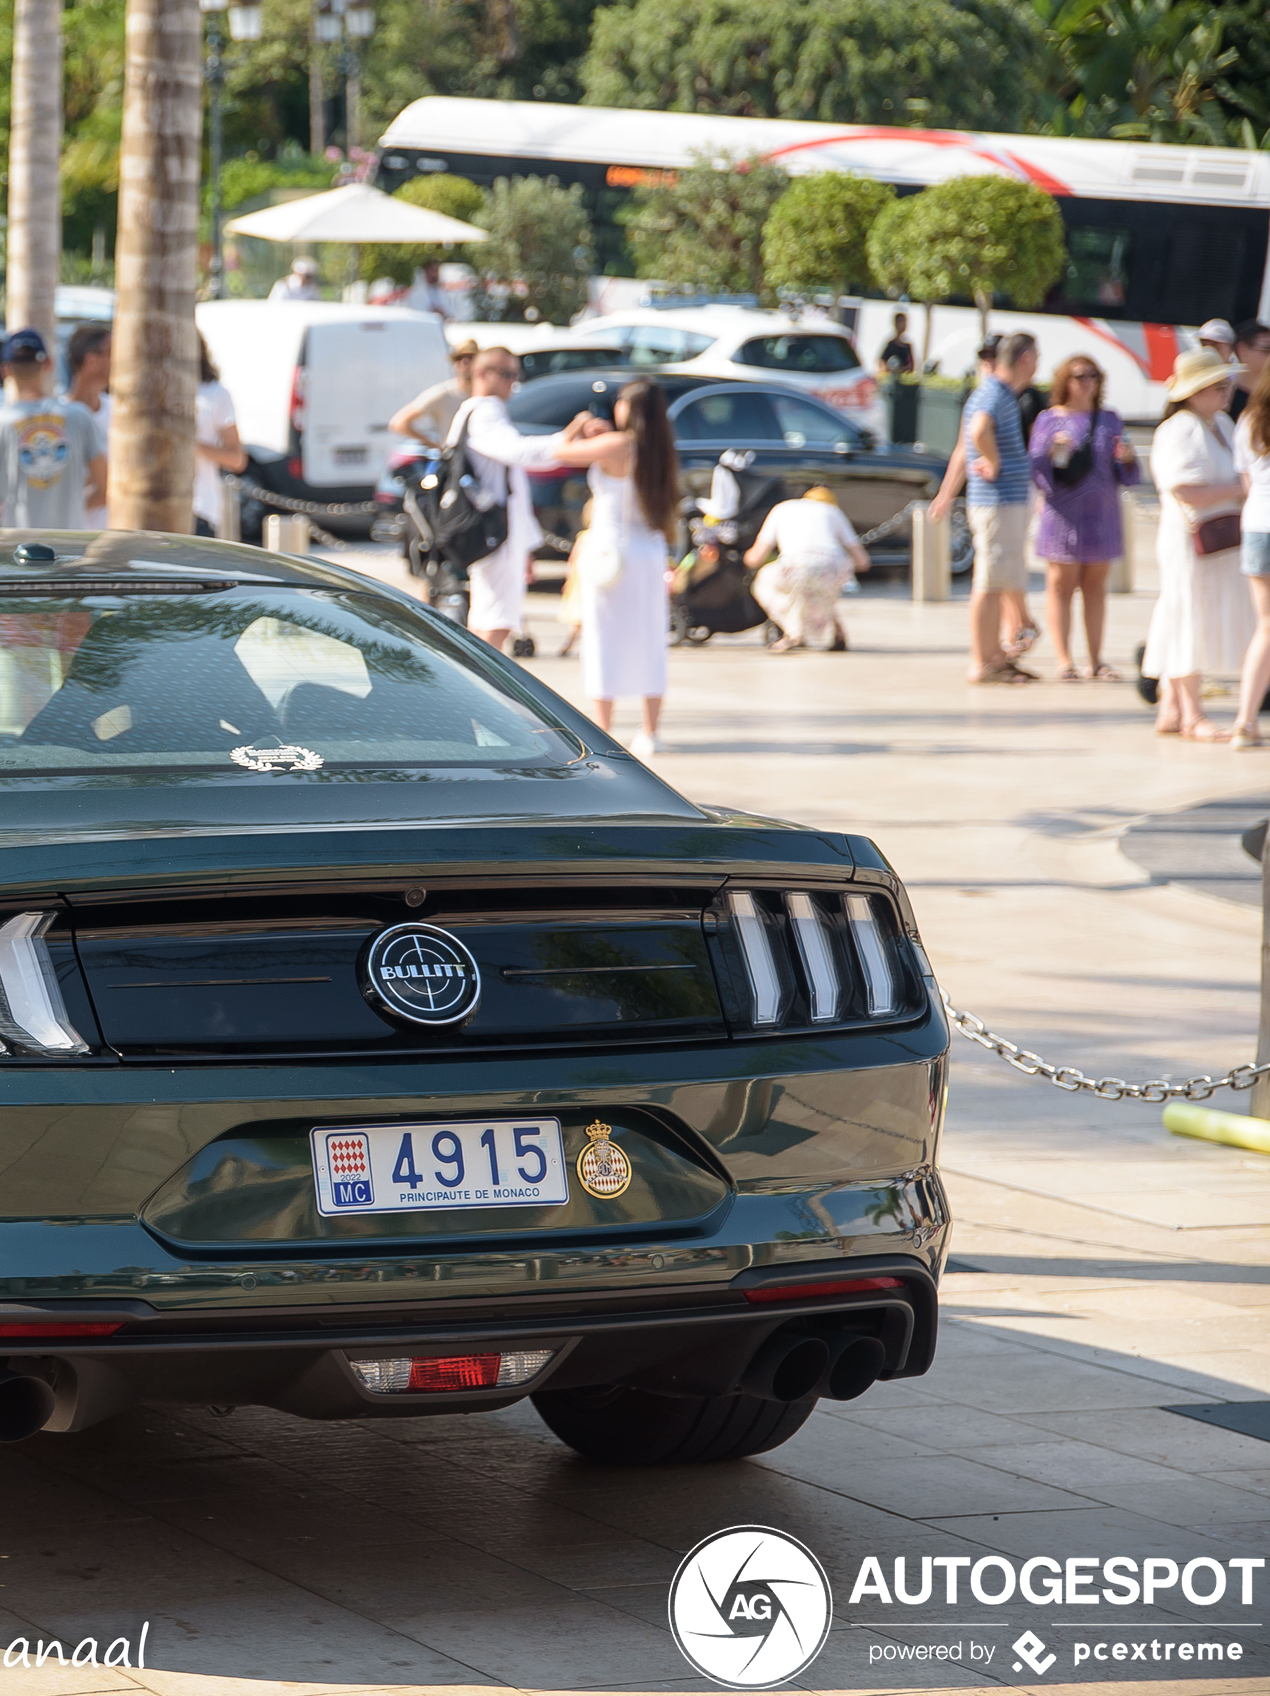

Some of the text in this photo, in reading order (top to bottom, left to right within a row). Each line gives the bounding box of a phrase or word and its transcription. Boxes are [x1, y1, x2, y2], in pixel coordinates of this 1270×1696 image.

[380, 963, 466, 980] BULLITT
[392, 1127, 547, 1189] 4915
[340, 1173, 362, 1182] 2022
[339, 1183, 367, 1202] MC
[399, 1187, 541, 1203] PRINCIPAUTE DE MONACO
